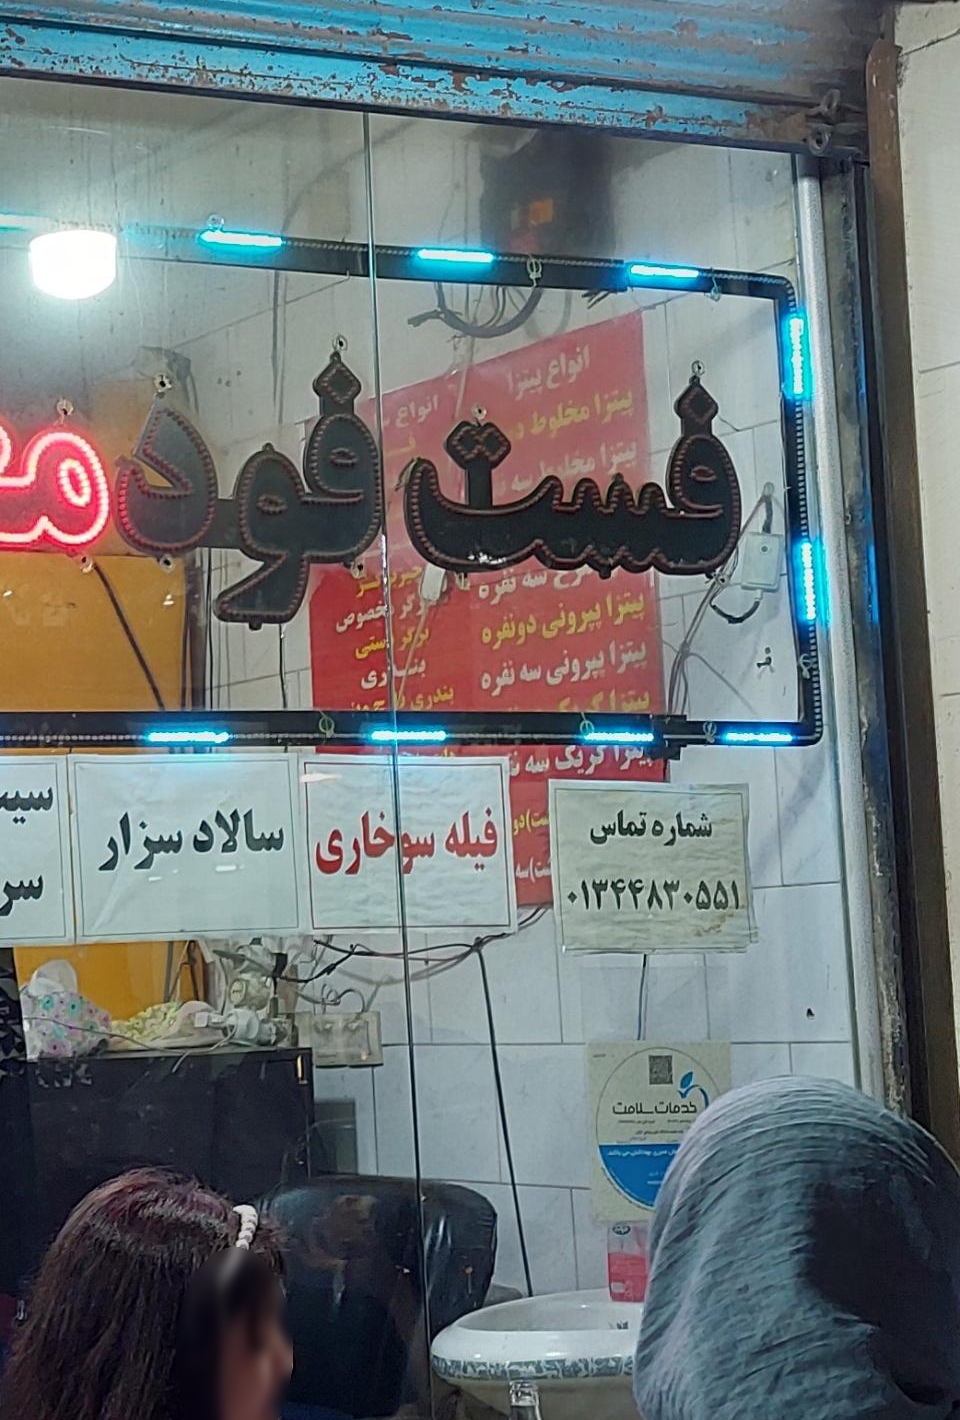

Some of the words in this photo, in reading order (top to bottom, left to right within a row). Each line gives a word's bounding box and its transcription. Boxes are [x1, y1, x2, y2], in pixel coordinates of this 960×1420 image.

[547, 344, 590, 389] انواع
[531, 399, 590, 438] مخلوط
[594, 390, 634, 424] پیتزا
[115, 351, 384, 630] فود
[403, 377, 742, 577] فست
[478, 567, 517, 605] نفره
[521, 567, 548, 588] سه
[542, 601, 602, 639] پپرونی
[606, 591, 646, 625] پیتزا
[519, 663, 542, 681] سه
[546, 649, 606, 686] پپرونی
[609, 639, 648, 674] پیتزا
[481, 660, 516, 697] نفره
[525, 754, 550, 774] سه
[98, 811, 184, 871] سزار
[192, 808, 285, 853] سالاد
[315, 810, 435, 875] سوخاری
[444, 807, 498, 870] فیله
[590, 809, 647, 845] تماس
[651, 811, 713, 847] شماره
[567, 878, 740, 911] ۰۱۳۴۴۸۳۰۵۵۱
